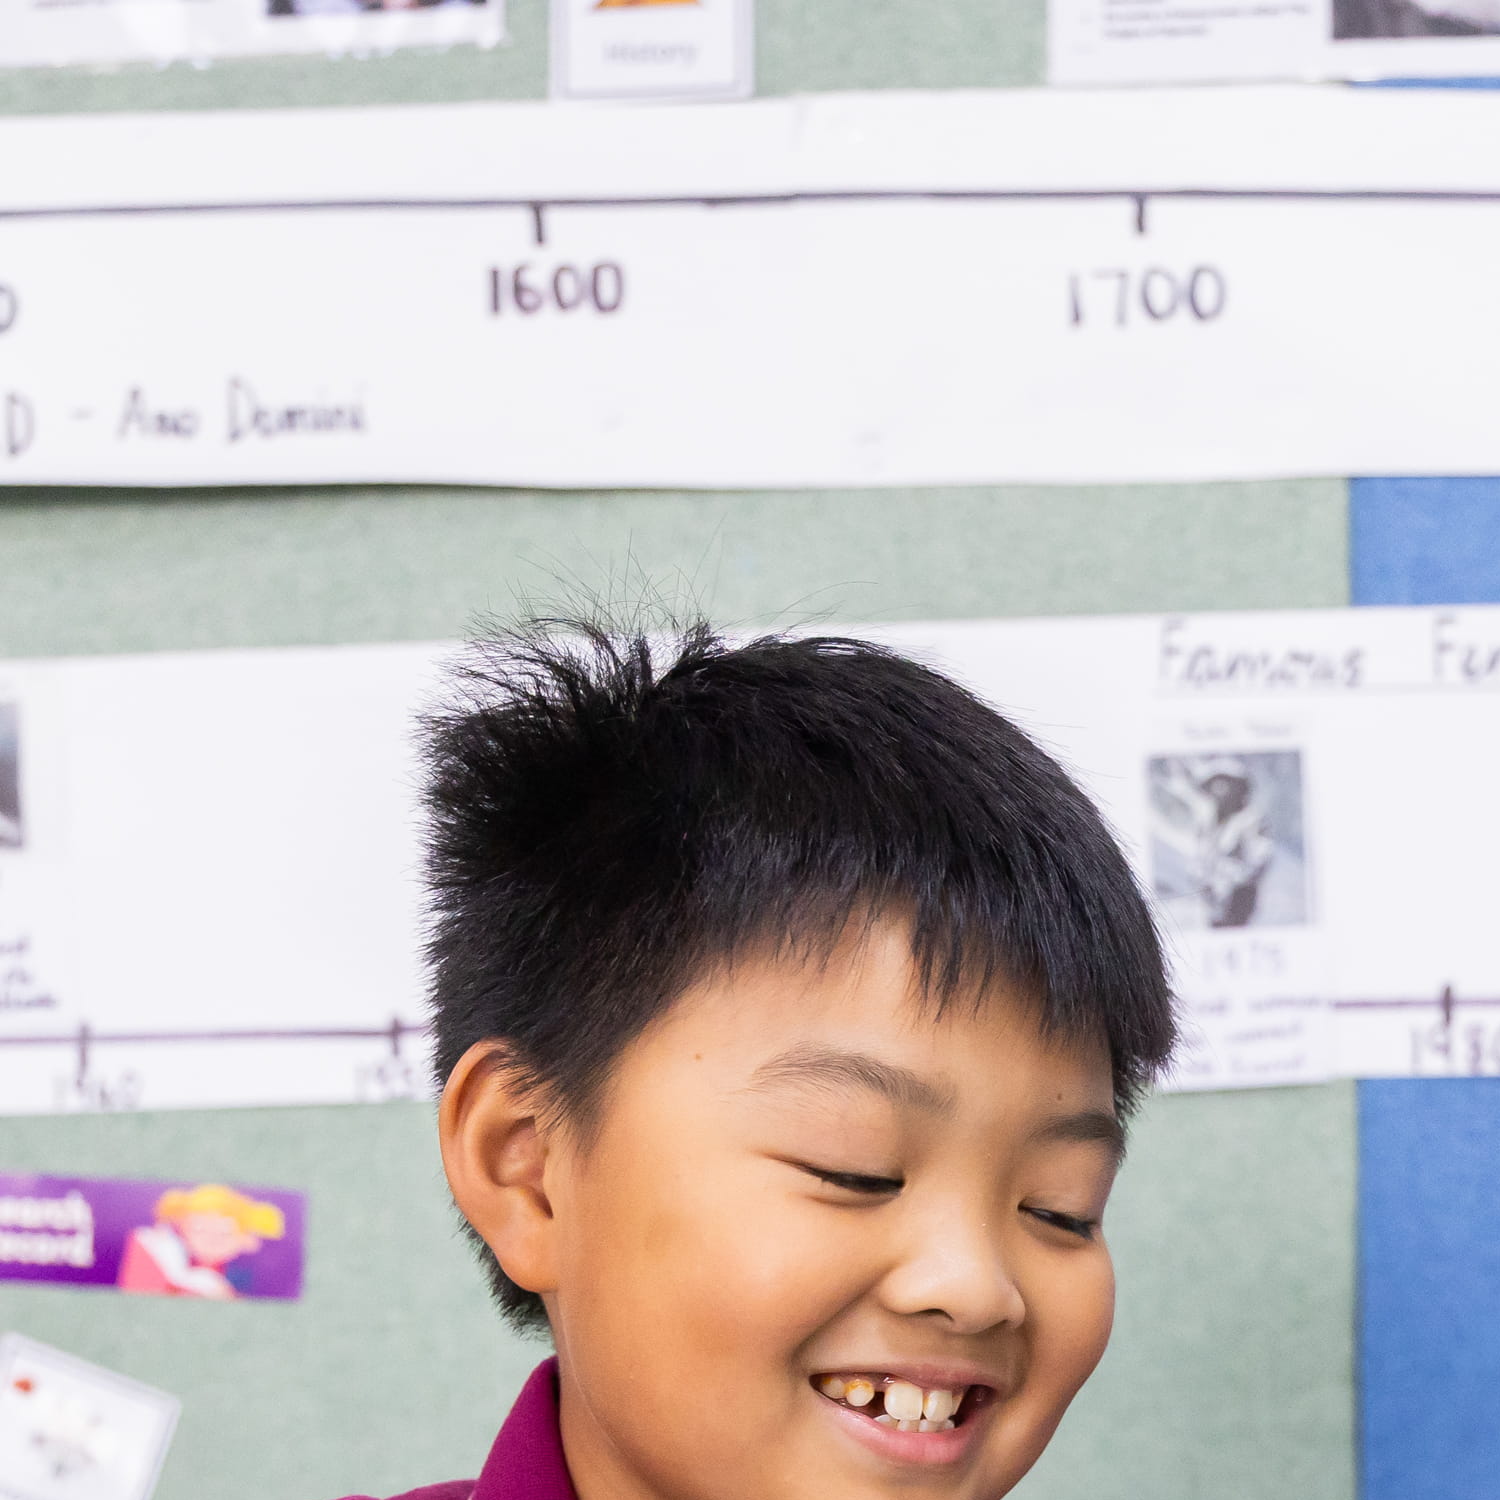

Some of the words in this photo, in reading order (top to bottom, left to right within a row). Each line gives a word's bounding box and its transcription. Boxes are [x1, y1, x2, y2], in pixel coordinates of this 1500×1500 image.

[487, 261, 625, 316] 1600
[1067, 263, 1229, 328] 1700
[1157, 616, 1367, 689] Famous
